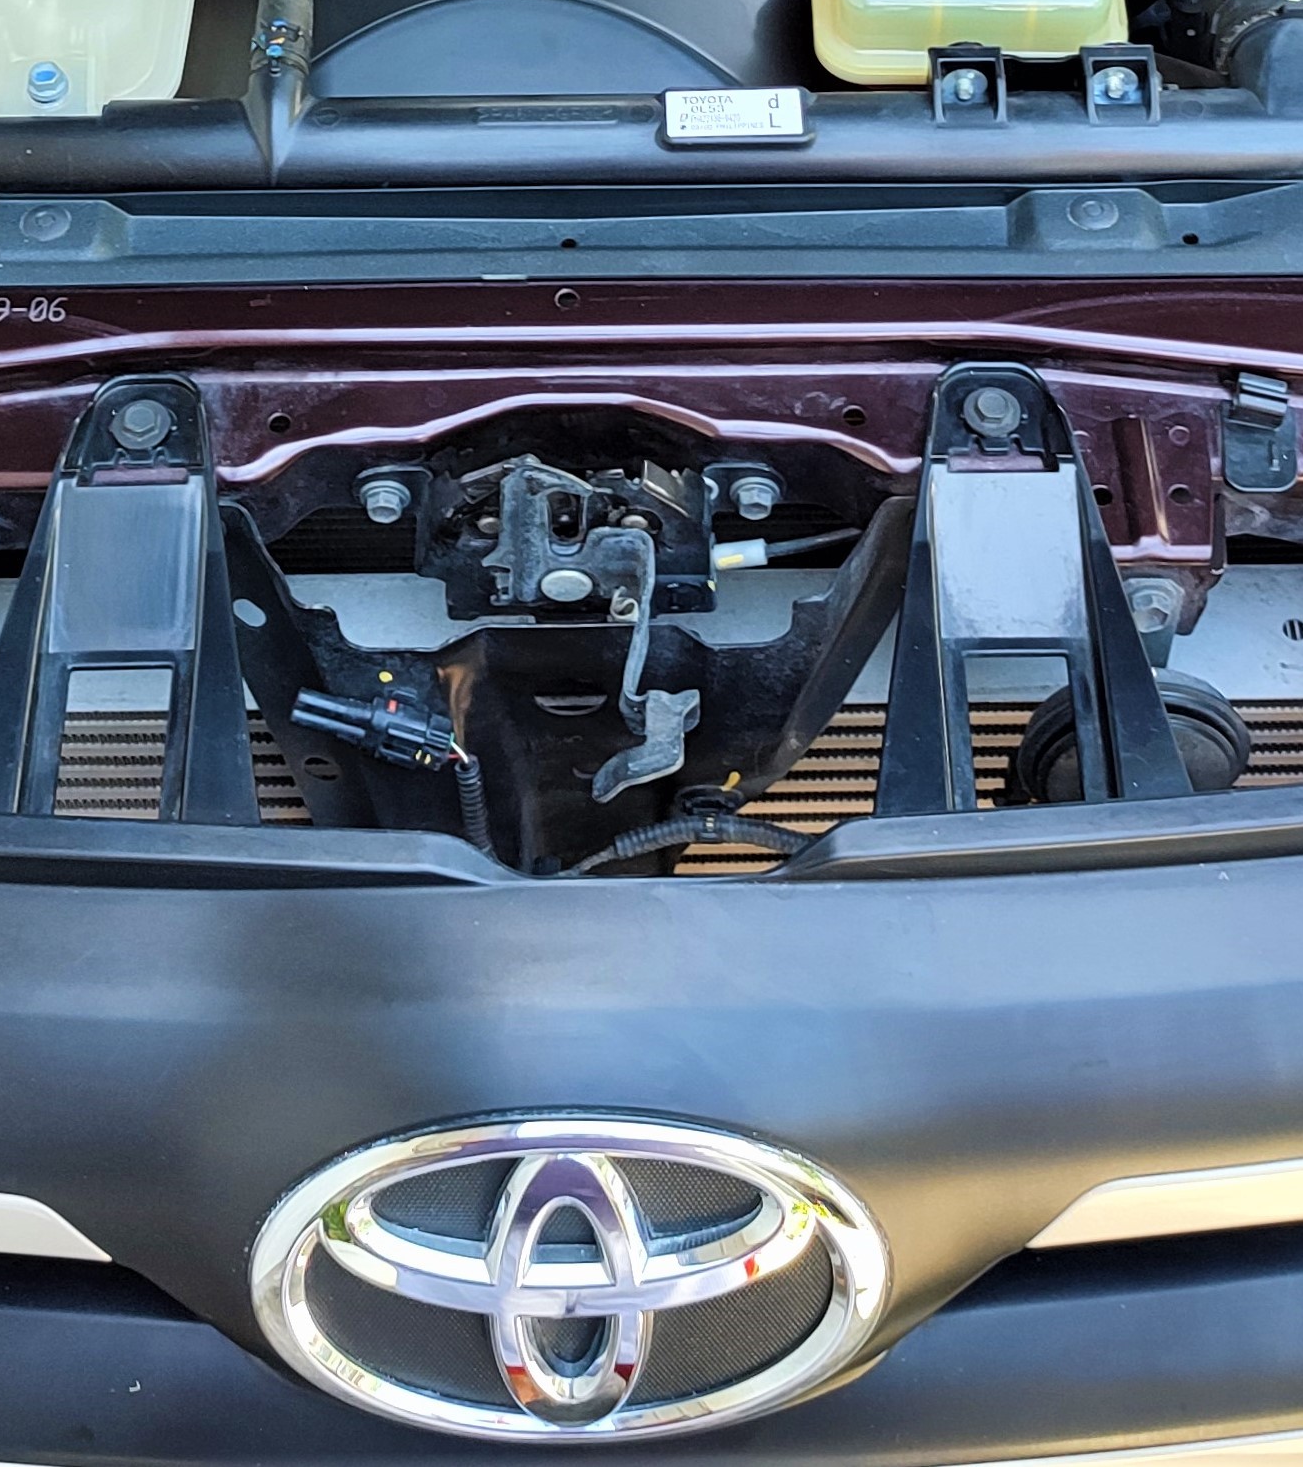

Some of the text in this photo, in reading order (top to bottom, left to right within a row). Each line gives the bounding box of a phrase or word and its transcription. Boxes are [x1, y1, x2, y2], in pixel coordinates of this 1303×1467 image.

[682, 95, 733, 105] TOYOTA
[767, 93, 780, 109] d
[768, 112, 782, 129] L
